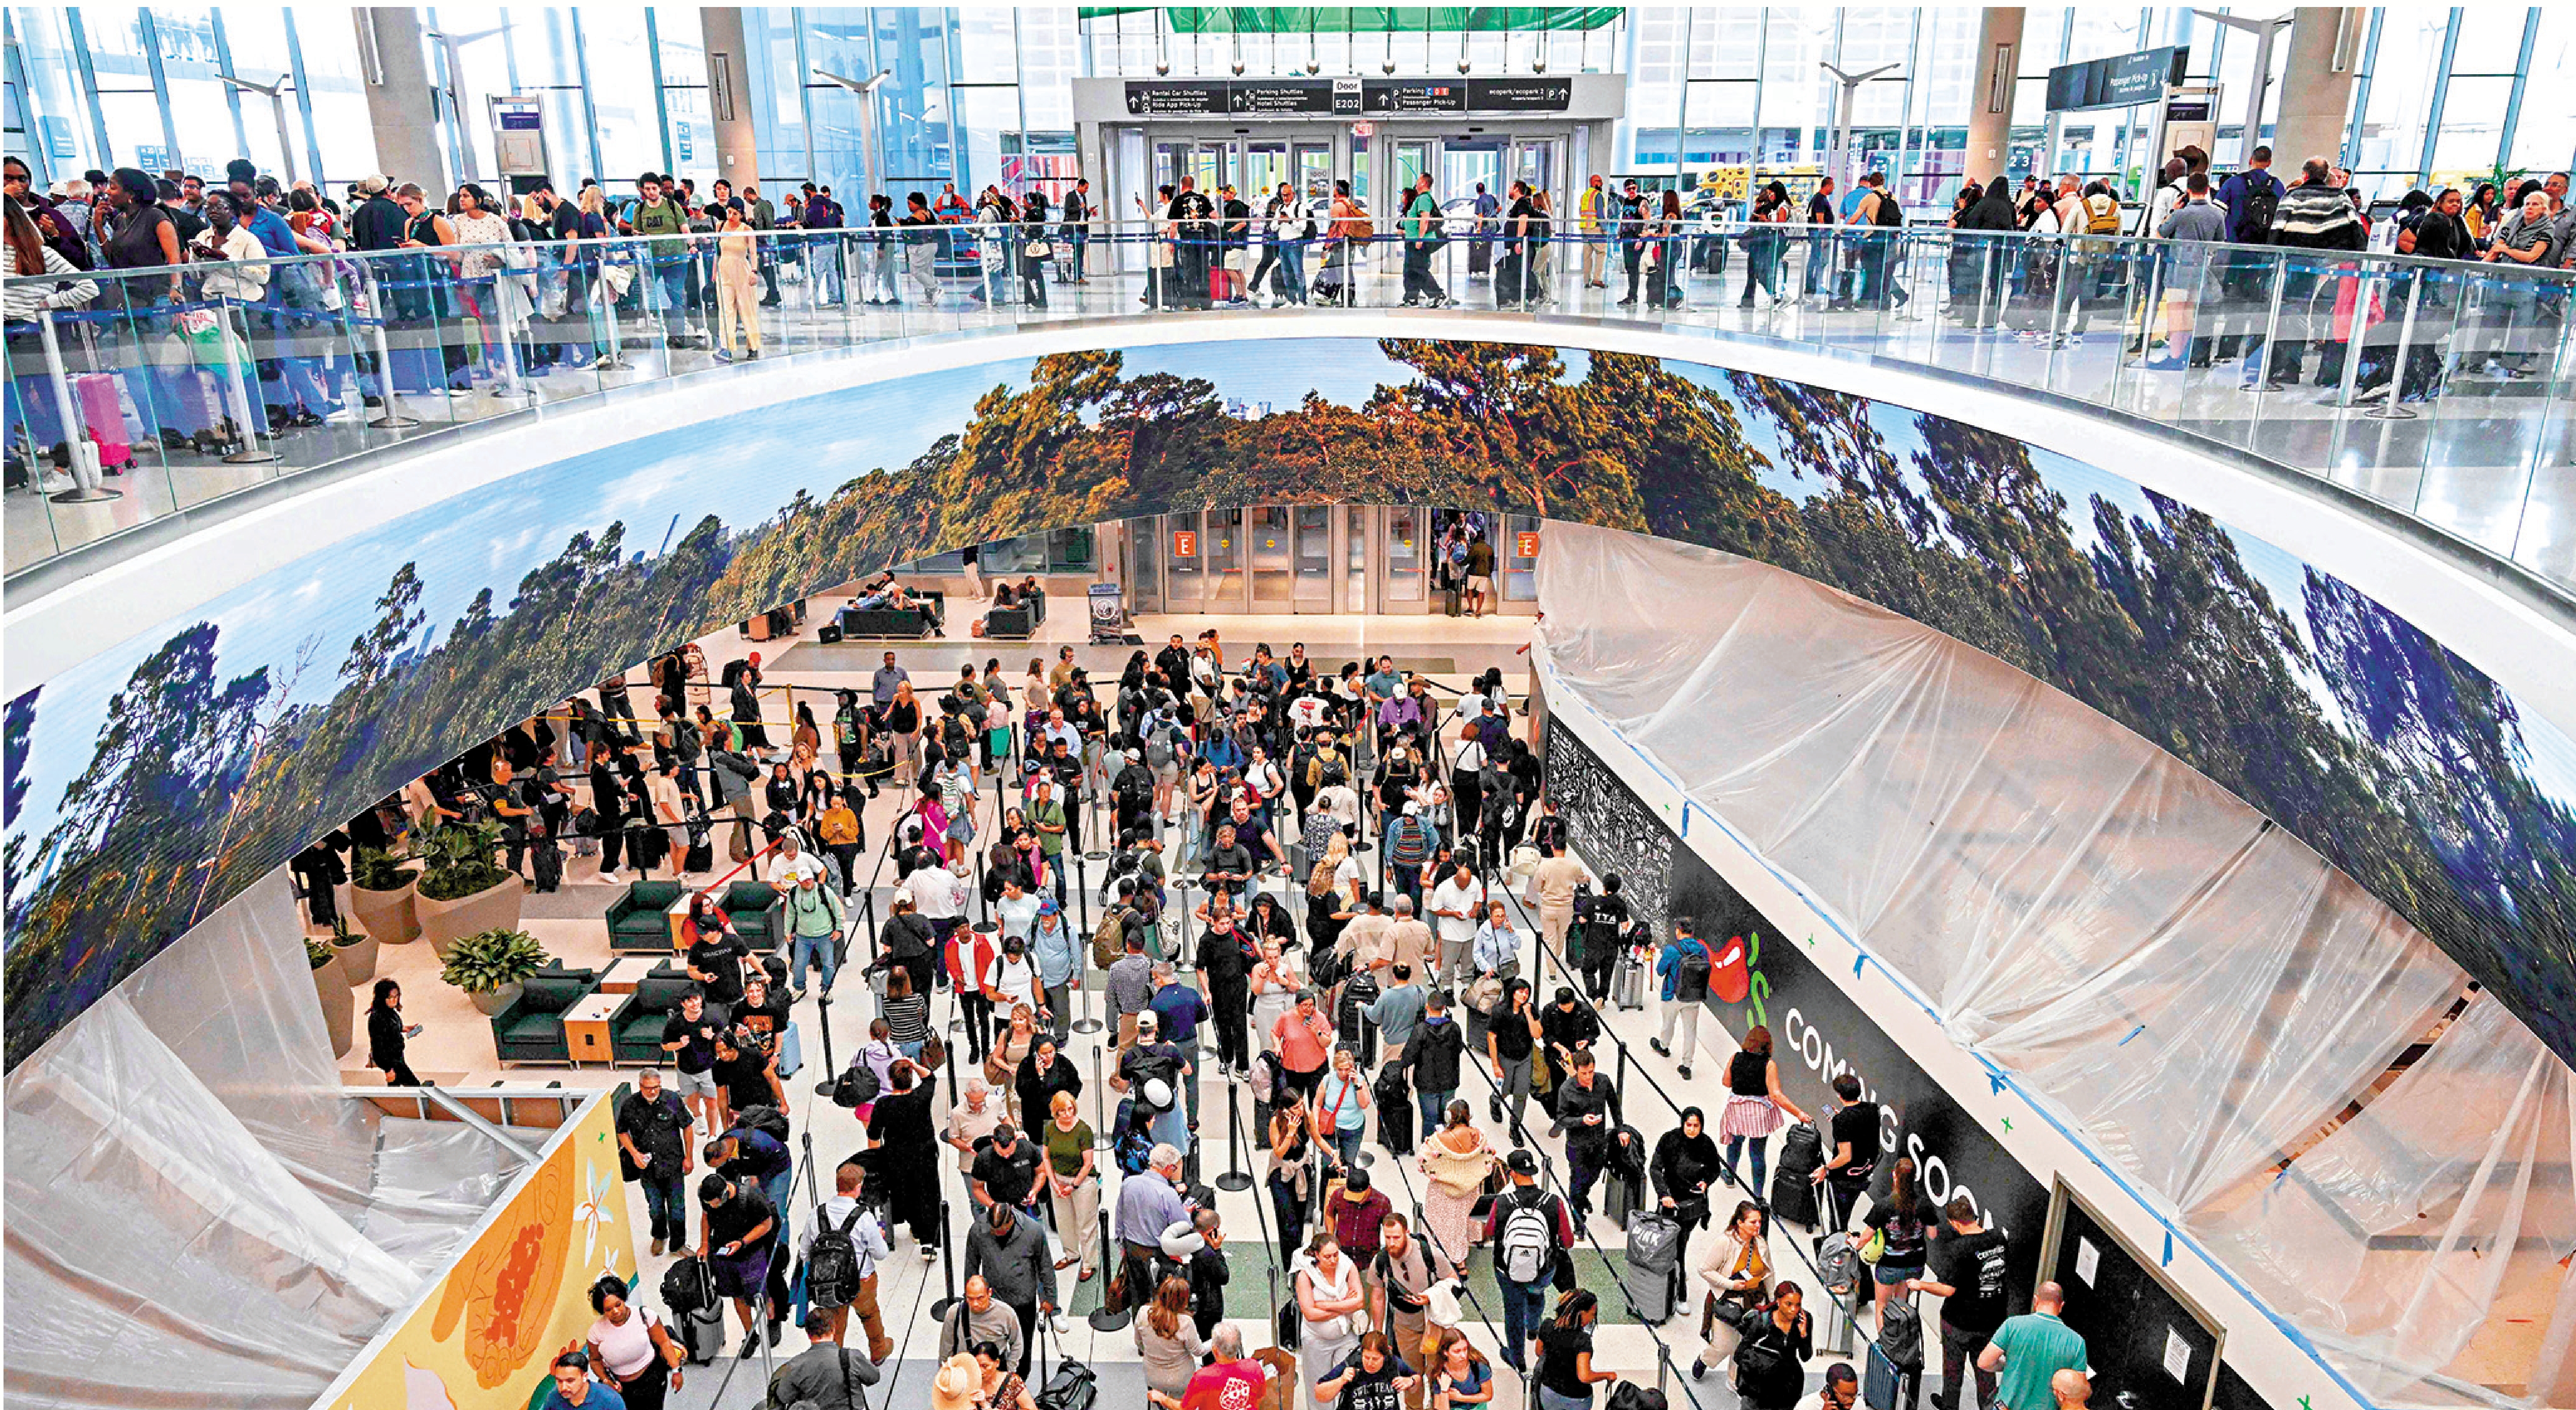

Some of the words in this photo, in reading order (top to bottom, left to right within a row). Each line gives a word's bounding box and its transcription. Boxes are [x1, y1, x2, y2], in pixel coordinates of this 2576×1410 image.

[1336, 81, 1358, 90] Door
[1335, 99, 1360, 108] E202
[2009, 155, 2017, 167] 2
[2021, 155, 2030, 167] 3
[1181, 538, 1190, 554] E
[1524, 539, 1532, 555] E
[1786, 1007, 1898, 1153] COMNG
